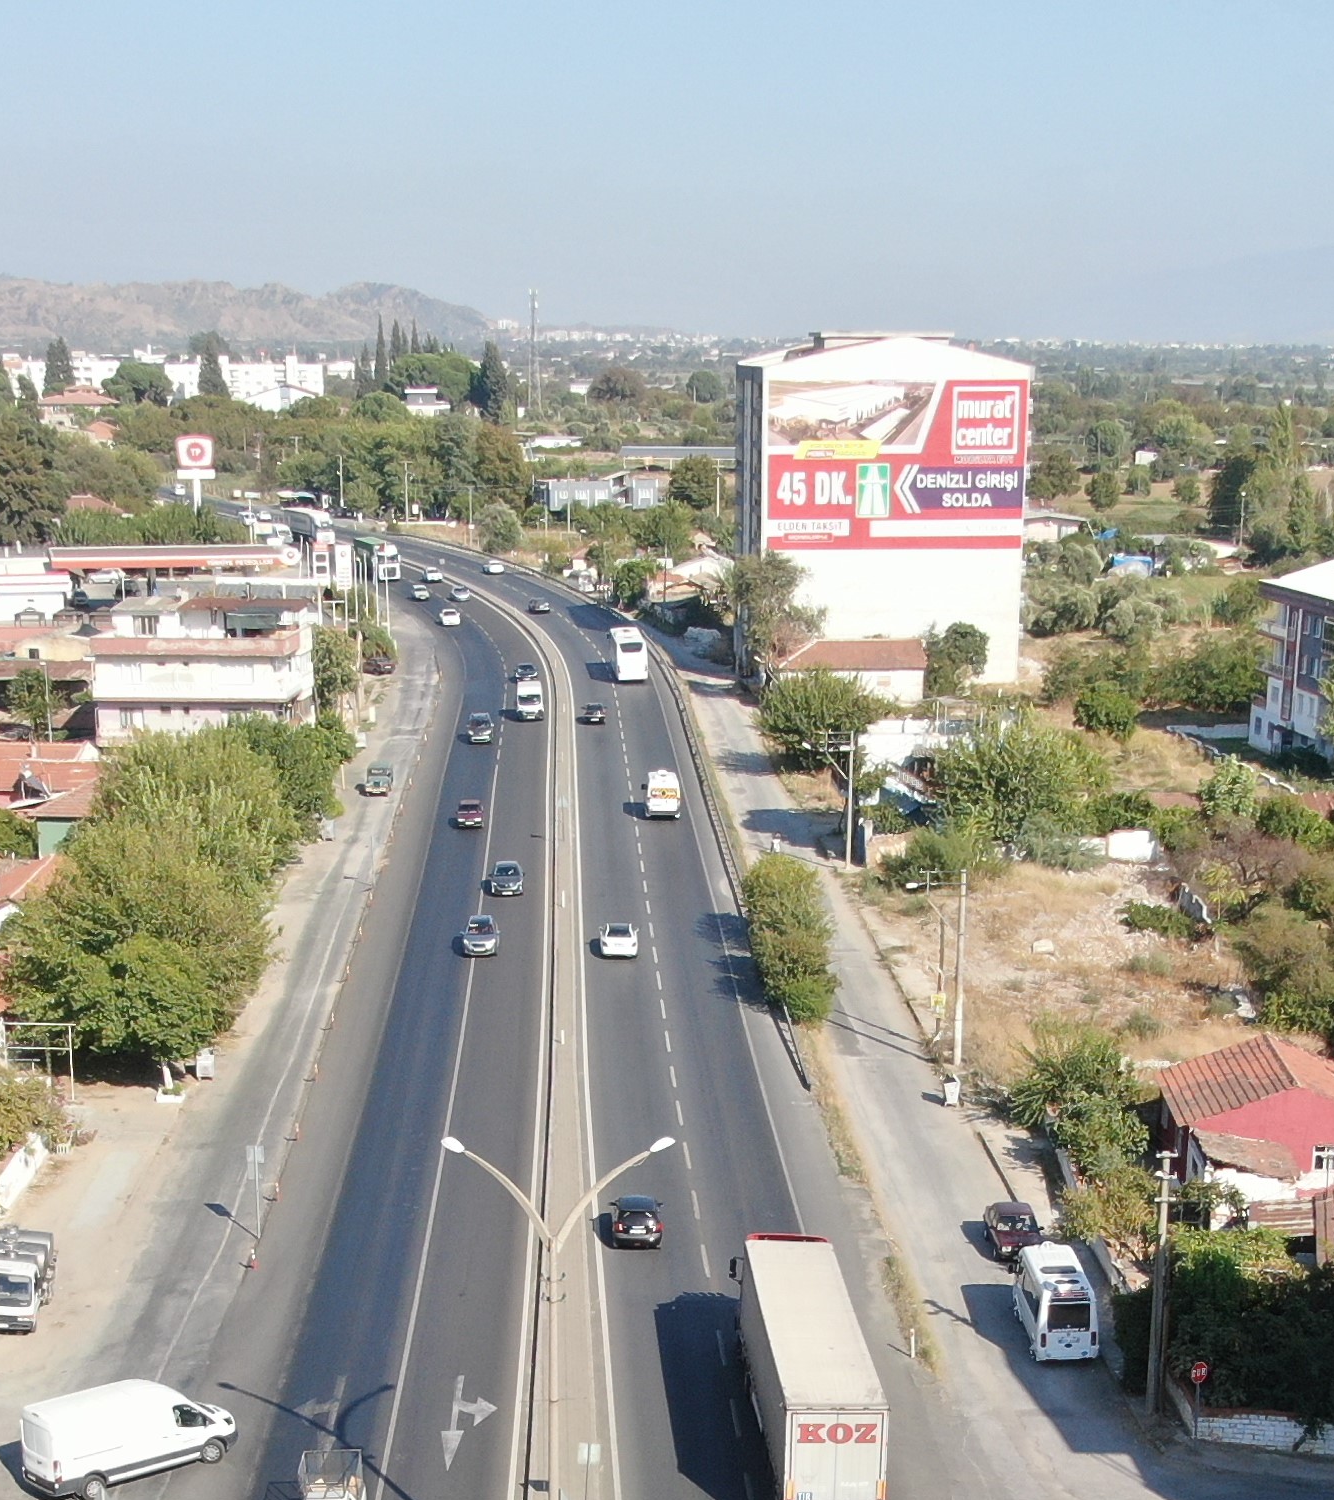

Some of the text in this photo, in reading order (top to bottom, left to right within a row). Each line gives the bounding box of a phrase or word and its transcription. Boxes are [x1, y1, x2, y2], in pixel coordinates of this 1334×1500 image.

[957, 395, 1013, 419] murat
[956, 423, 1012, 446] center
[190, 447, 202, 457] TP
[776, 471, 853, 506] 45 DK.
[916, 470, 1018, 491] DENİZLİ GİRİŞİ
[942, 493, 993, 507] SOLDA
[777, 522, 844, 531] ELDEN TAKSİT
[796, 1423, 878, 1445] KOZ
